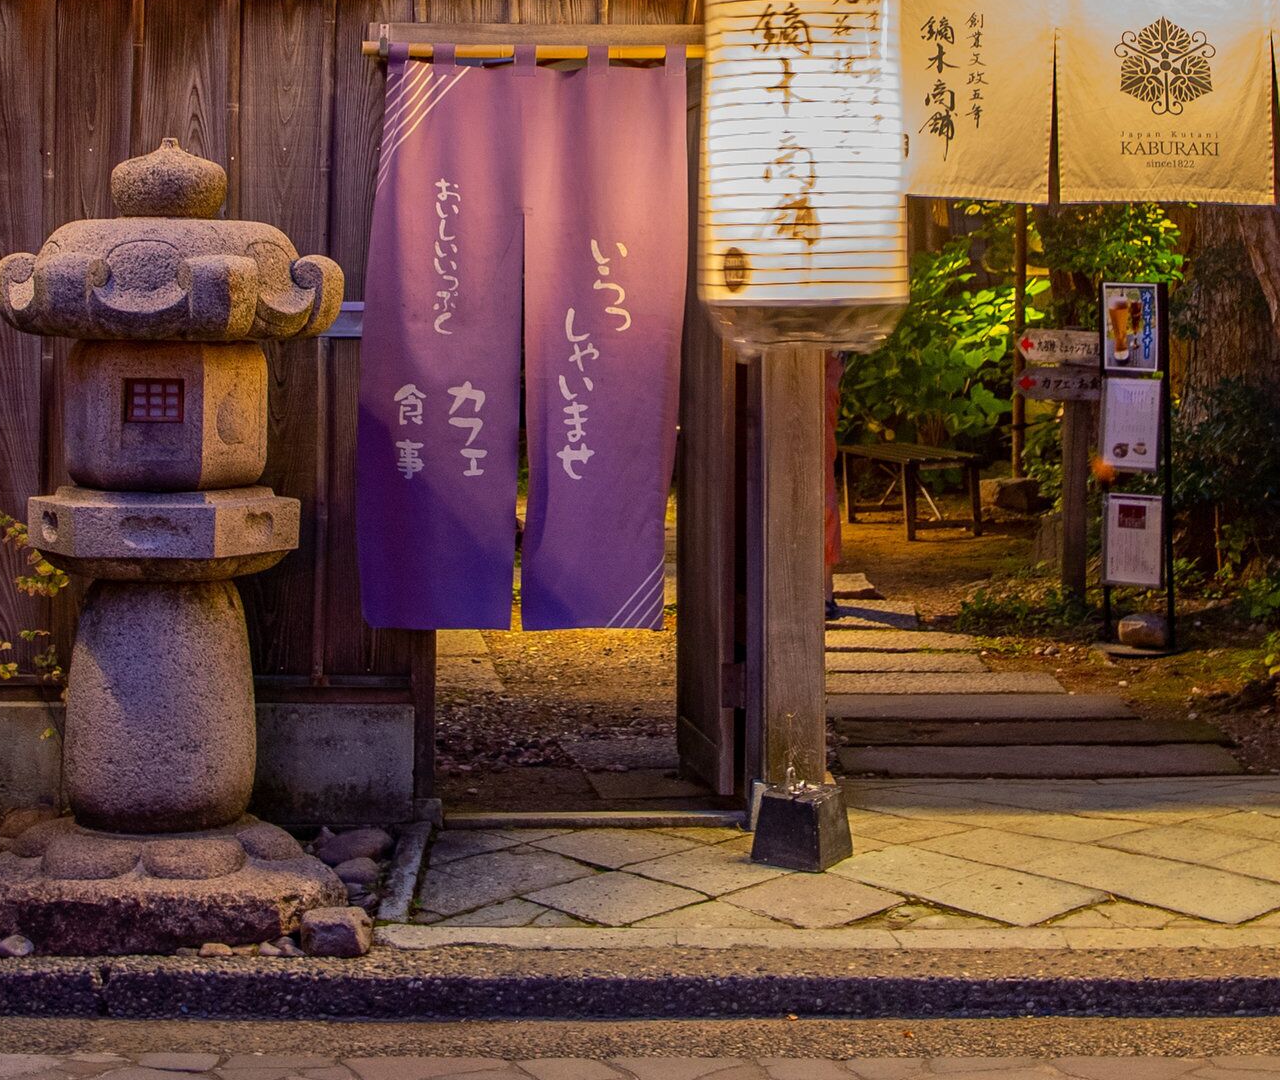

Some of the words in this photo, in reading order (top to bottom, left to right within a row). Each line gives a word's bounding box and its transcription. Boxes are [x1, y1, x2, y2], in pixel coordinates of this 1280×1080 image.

[919, 16, 960, 162] 鏑木商舗
[965, 12, 989, 129] 創業文政五年
[1120, 131, 1161, 139] Japan
[1120, 141, 1220, 156] KABURAKI
[434, 176, 461, 335] おいしいいっぷく
[590, 239, 632, 332] いらっ
[394, 383, 428, 480] 食事
[447, 381, 486, 477] カフェ
[556, 307, 600, 480] しゃいませ
